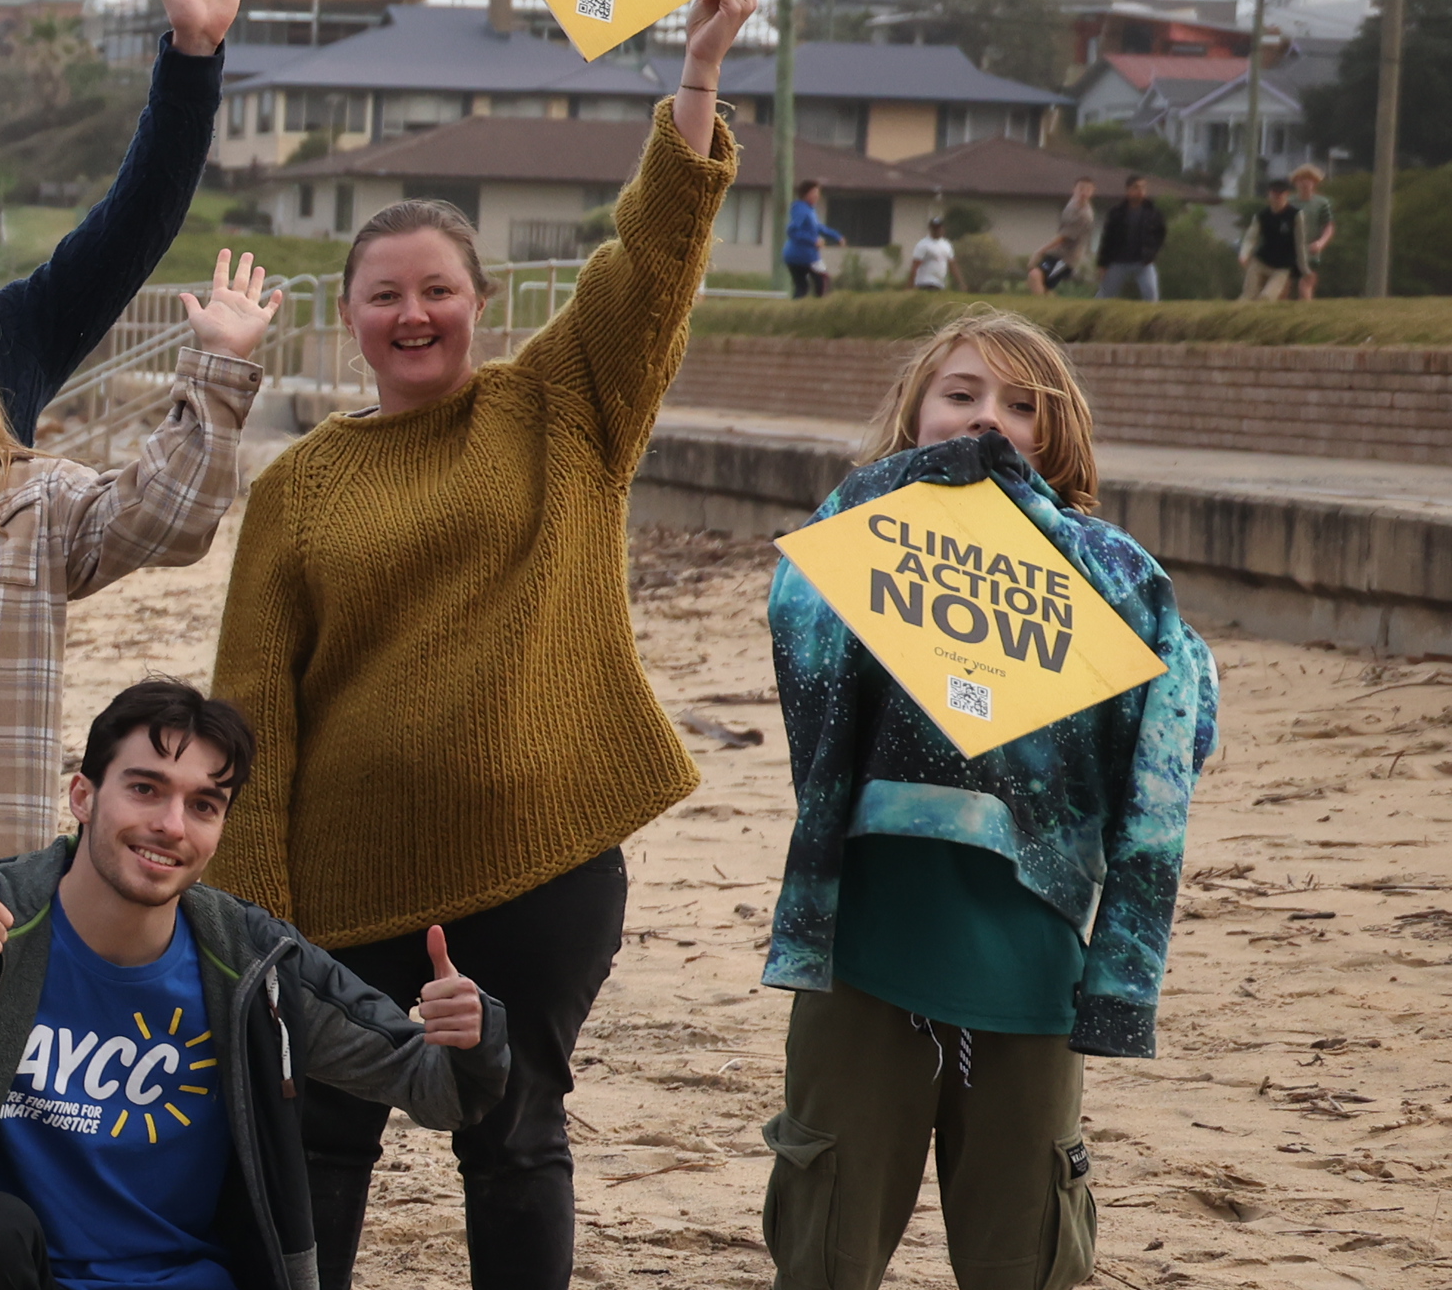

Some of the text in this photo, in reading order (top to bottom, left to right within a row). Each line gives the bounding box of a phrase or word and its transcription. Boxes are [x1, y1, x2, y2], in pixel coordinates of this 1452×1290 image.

[868, 514, 1071, 601] CLIMATE
[895, 551, 1073, 630] ACTION
[870, 567, 1073, 674] NOW
[934, 645, 1007, 678] Order yours
[16, 1024, 179, 1105] AYCC
[0, 1104, 101, 1134] IMATE JUSTICE
[25, 1096, 80, 1115] FIGHTING
[81, 1104, 103, 1119] FOR
